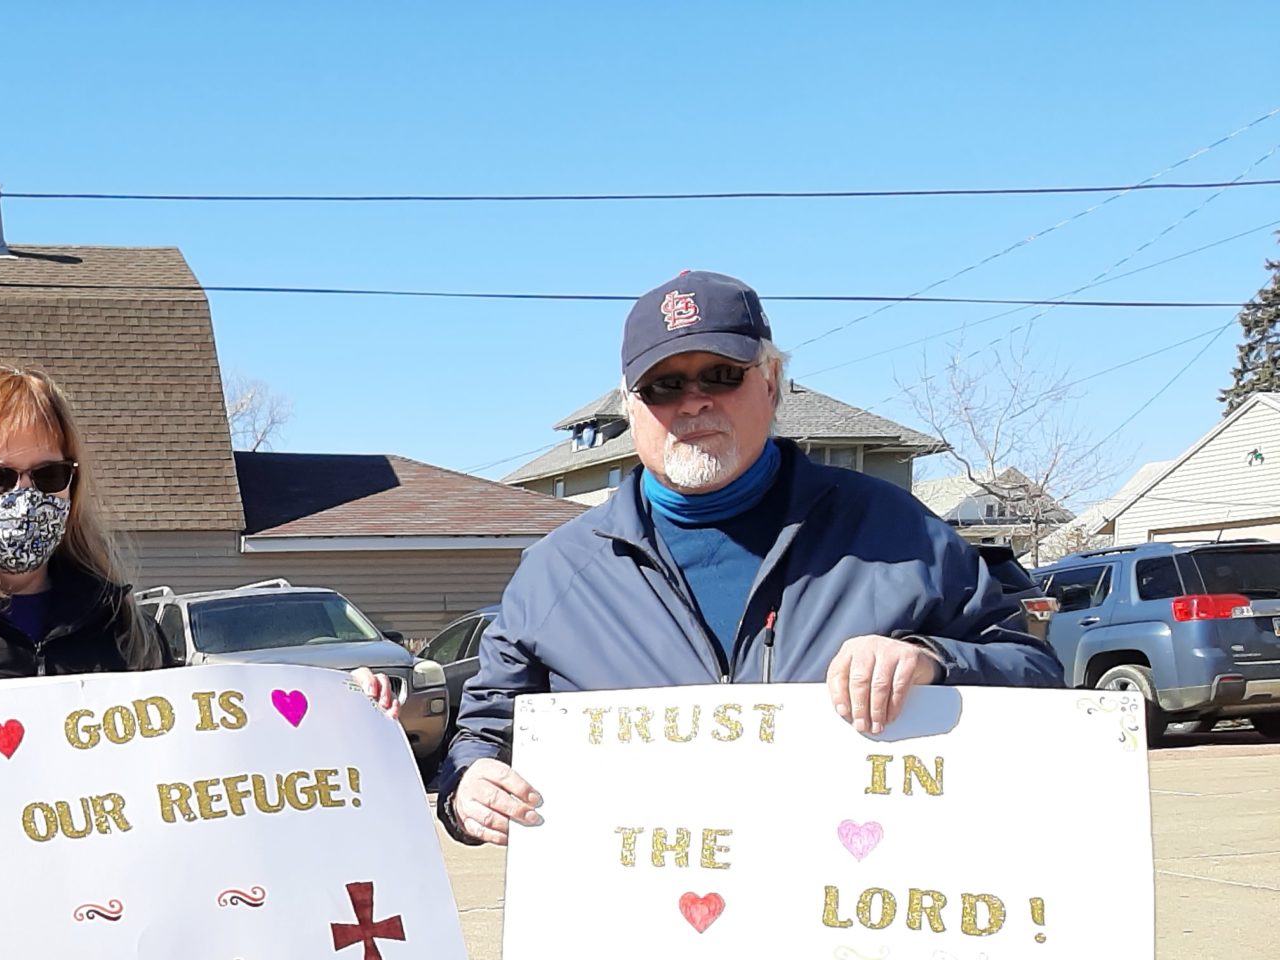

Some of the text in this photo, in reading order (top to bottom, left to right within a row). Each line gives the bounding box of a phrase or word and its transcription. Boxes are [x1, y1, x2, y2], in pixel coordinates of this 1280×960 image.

[64, 690, 248, 750] GOD IS
[582, 702, 785, 745] TRUST
[864, 754, 945, 796] IN
[21, 767, 363, 842] OUR REFUGE!
[614, 826, 734, 870] THE
